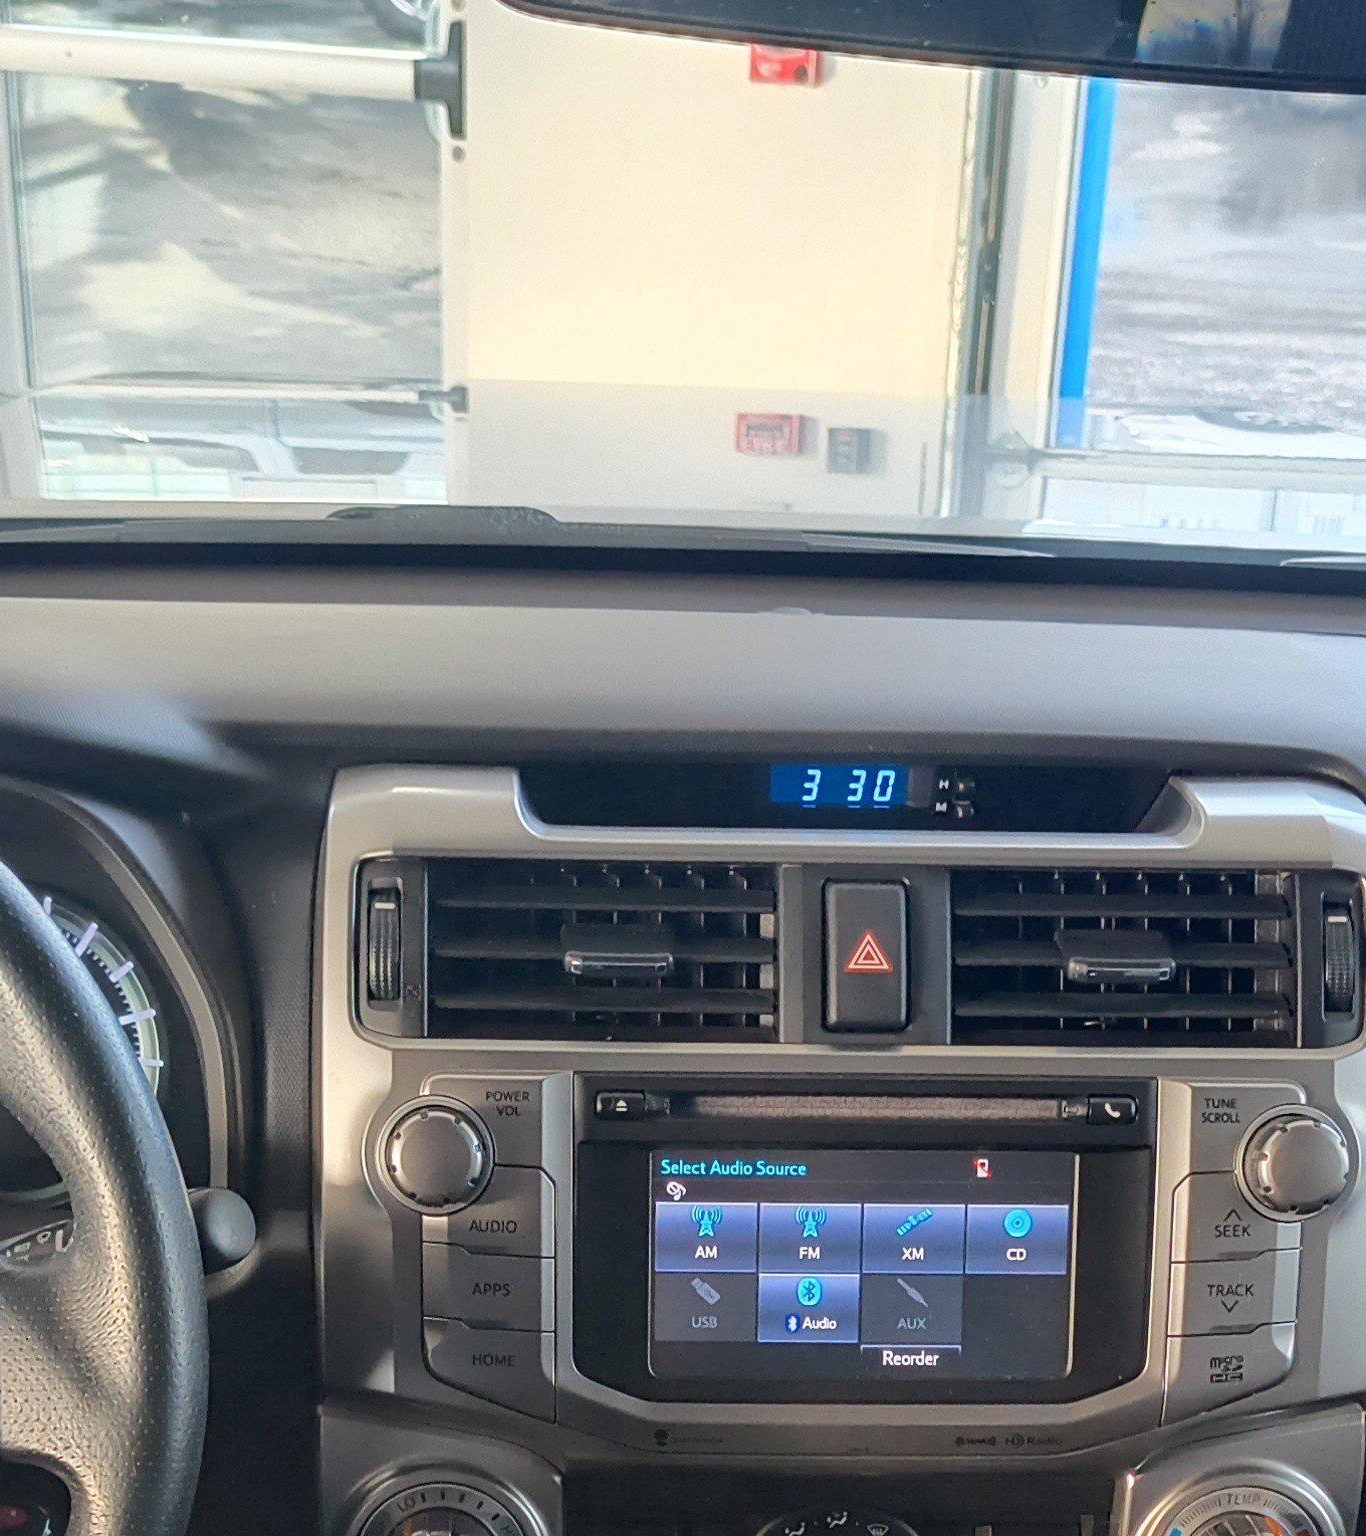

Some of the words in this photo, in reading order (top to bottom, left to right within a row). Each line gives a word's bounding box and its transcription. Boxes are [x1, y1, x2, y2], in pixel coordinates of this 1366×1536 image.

[939, 779, 949, 790] H
[935, 801, 947, 812] M
[485, 1090, 530, 1102] POWER
[1203, 1098, 1238, 1110] TUNE
[496, 1105, 521, 1117] VOL
[1201, 1112, 1240, 1124] SCROLL
[660, 1159, 707, 1175] Select
[709, 1160, 753, 1176] Audio
[756, 1161, 807, 1177] Source
[469, 1219, 517, 1233] AUDIO
[1215, 1224, 1251, 1238] SEEK
[694, 1246, 718, 1259] AM
[798, 1247, 821, 1260] FM
[901, 1247, 925, 1261] XM
[1006, 1248, 1027, 1261] CD
[472, 1283, 511, 1297] APPS
[1207, 1284, 1254, 1297] TRACK
[691, 1316, 718, 1329] USB
[802, 1316, 837, 1330] Audio
[897, 1317, 926, 1330] AUX
[472, 1353, 516, 1367] HOME
[882, 1350, 940, 1366] Reorder
[397, 1495, 416, 1512] LO
[1226, 1493, 1261, 1506] TEMP
